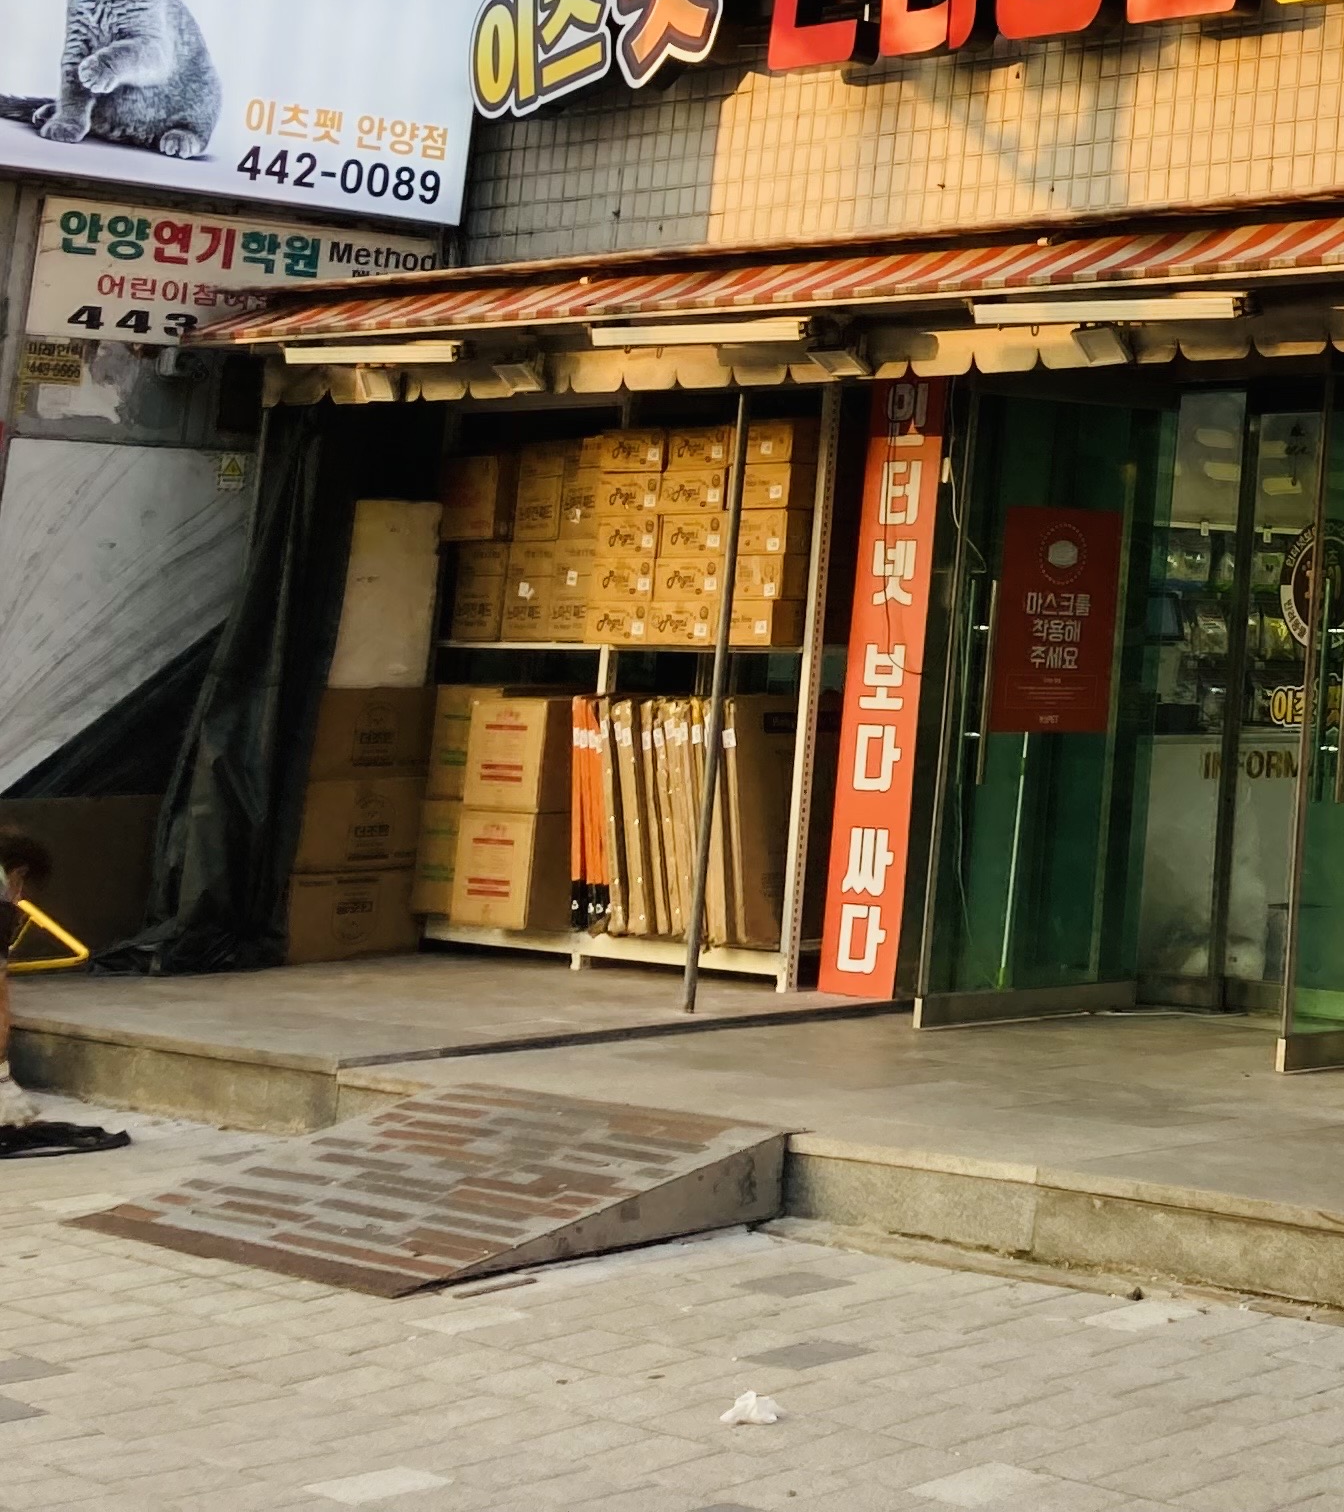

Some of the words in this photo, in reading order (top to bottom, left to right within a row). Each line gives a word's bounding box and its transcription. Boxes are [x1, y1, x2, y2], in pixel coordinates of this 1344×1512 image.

[244, 97, 345, 147] 이츠펫
[356, 112, 450, 162] 안양점
[237, 144, 443, 206] 442-0089
[58, 209, 322, 279] 안양연기학원
[328, 240, 439, 273] Method
[872, 381, 929, 607] 인터넷
[1025, 591, 1092, 617] 마스크를
[1031, 618, 1081, 644] 착용해
[1029, 646, 1079, 670] 주세요
[853, 642, 907, 794] 보다
[835, 825, 895, 975] 싸다
